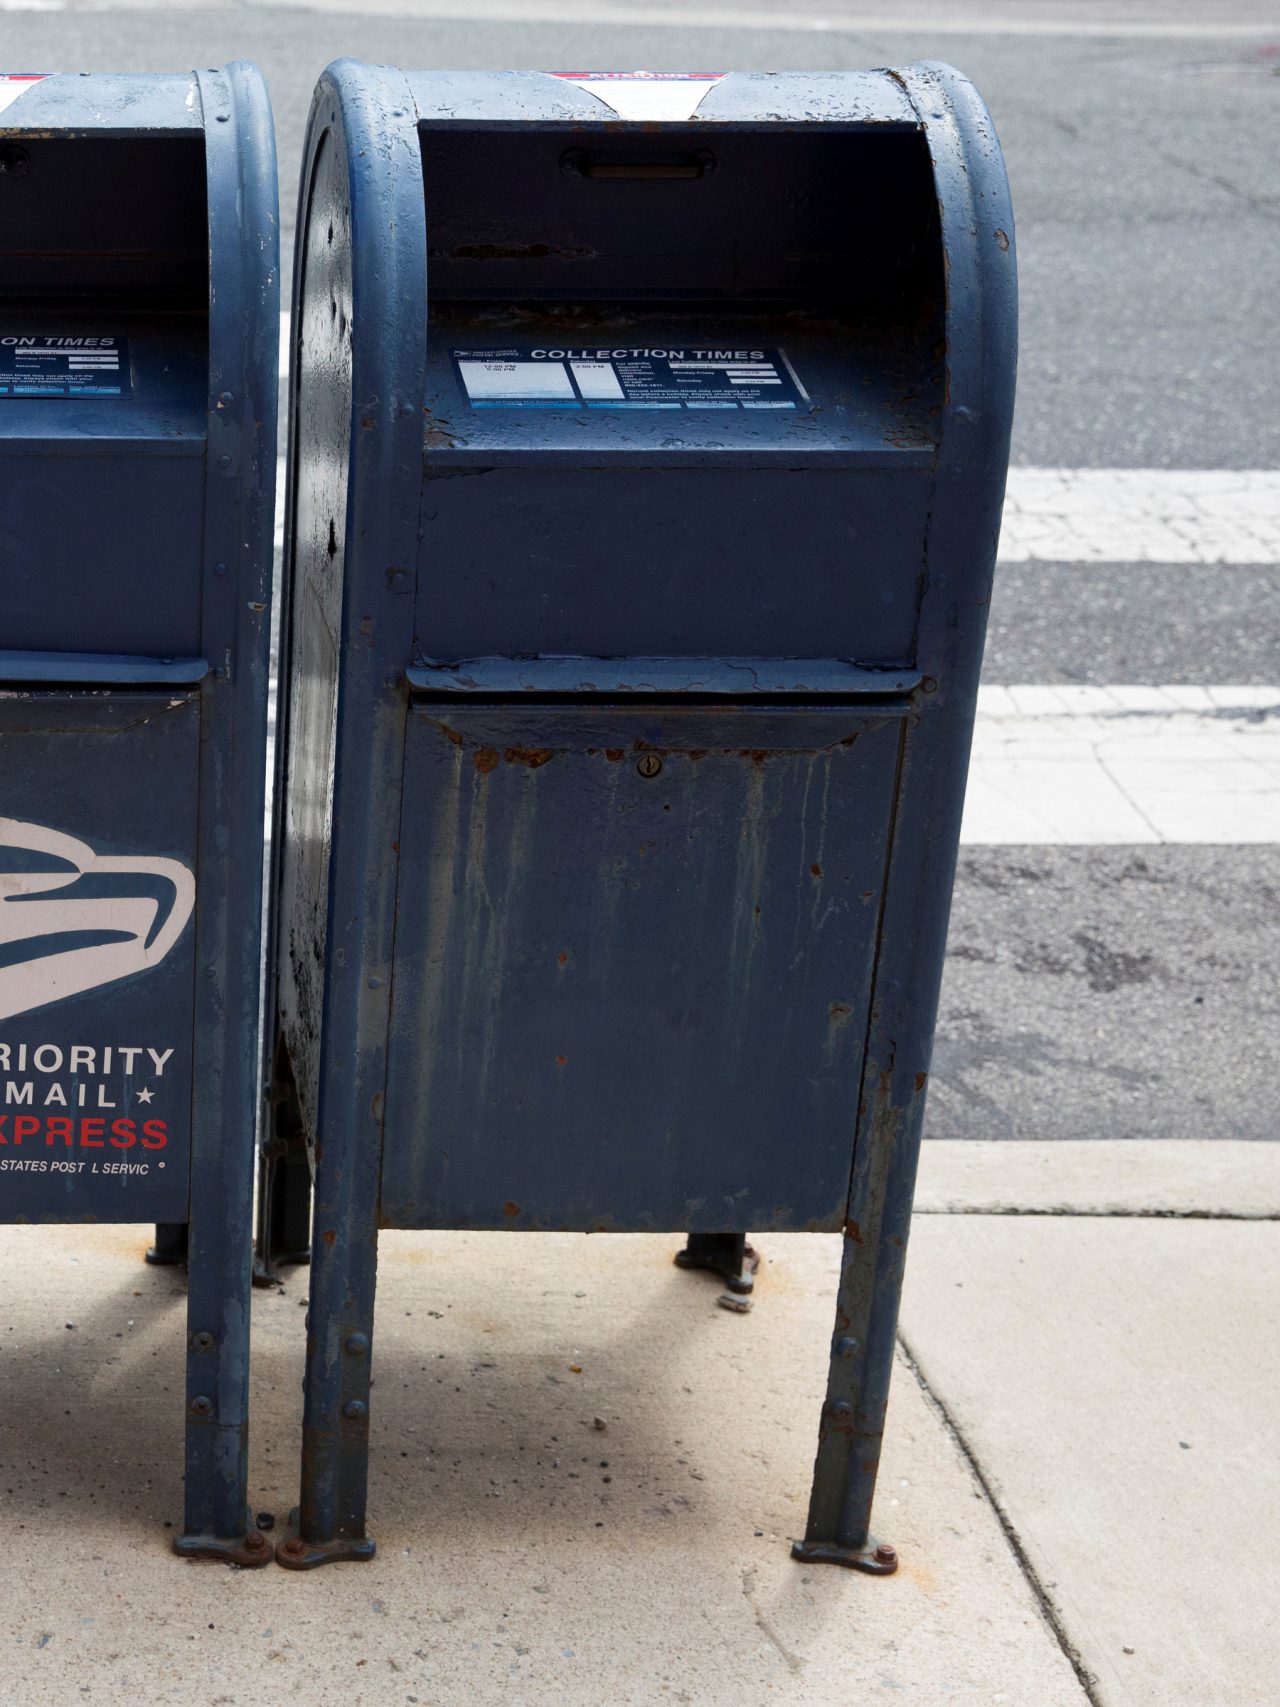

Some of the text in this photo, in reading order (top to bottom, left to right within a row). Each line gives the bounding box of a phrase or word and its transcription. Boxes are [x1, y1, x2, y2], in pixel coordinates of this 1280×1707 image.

[43, 337, 115, 346] TIMES
[530, 349, 765, 359] COLLECTION TIMES
[5, 1081, 117, 1108] MAIL
[0, 1159, 47, 1172] STATES
